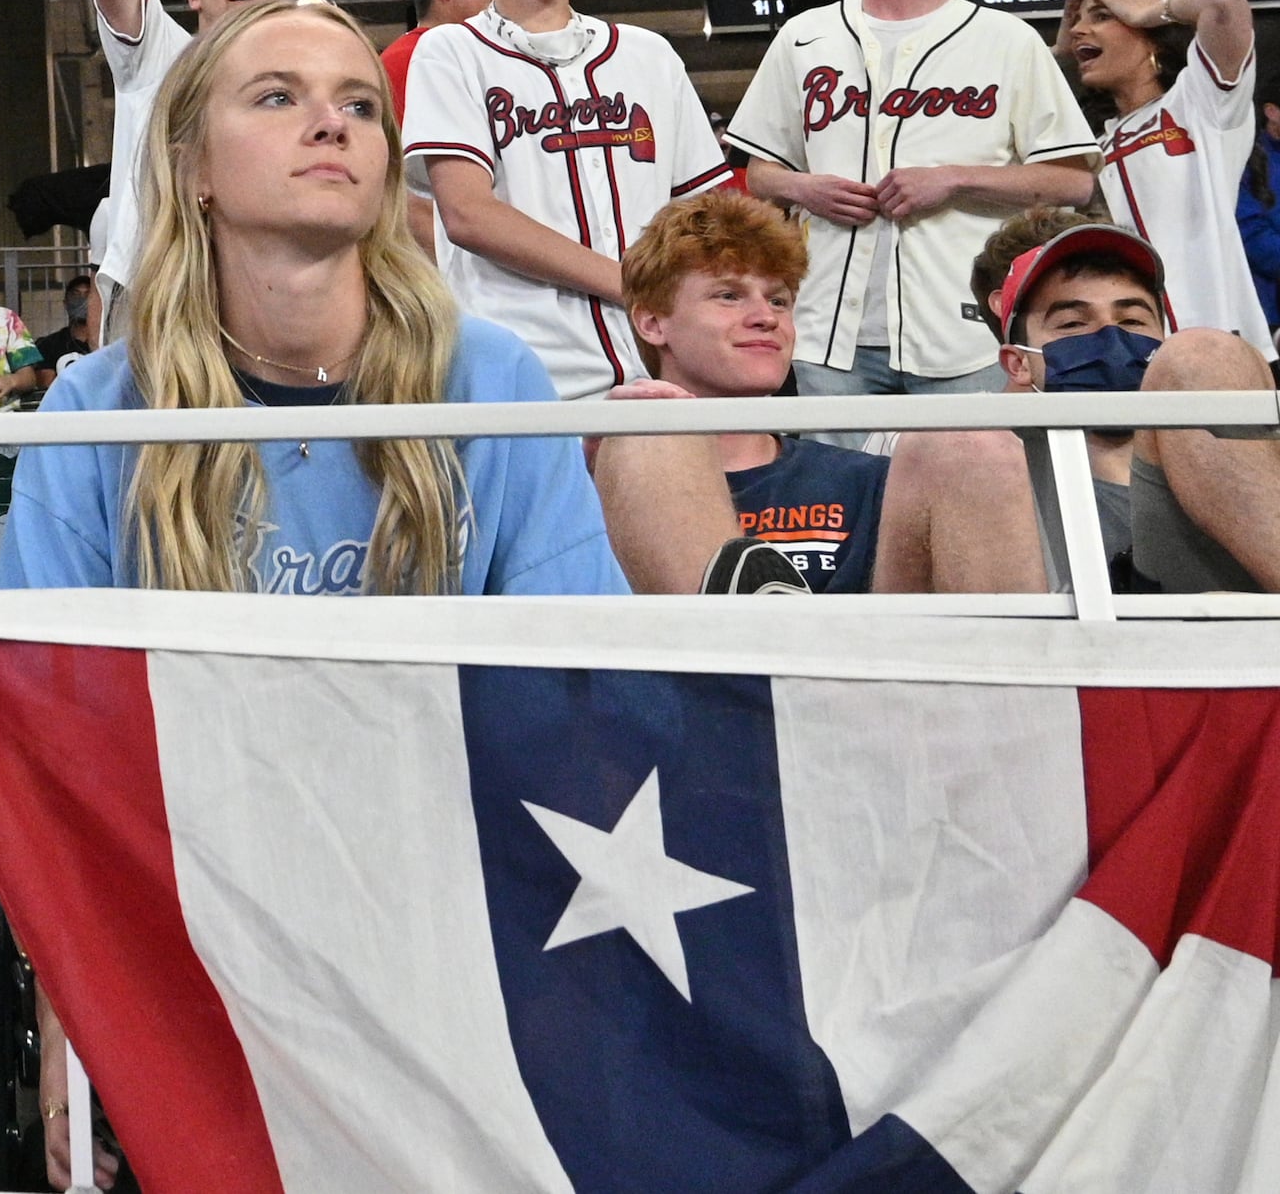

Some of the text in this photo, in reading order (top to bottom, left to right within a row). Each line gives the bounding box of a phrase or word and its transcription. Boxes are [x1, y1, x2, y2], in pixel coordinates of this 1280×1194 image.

[485, 86, 627, 157] Braves
[802, 65, 999, 142] Braves
[740, 504, 843, 532] PRINGS
